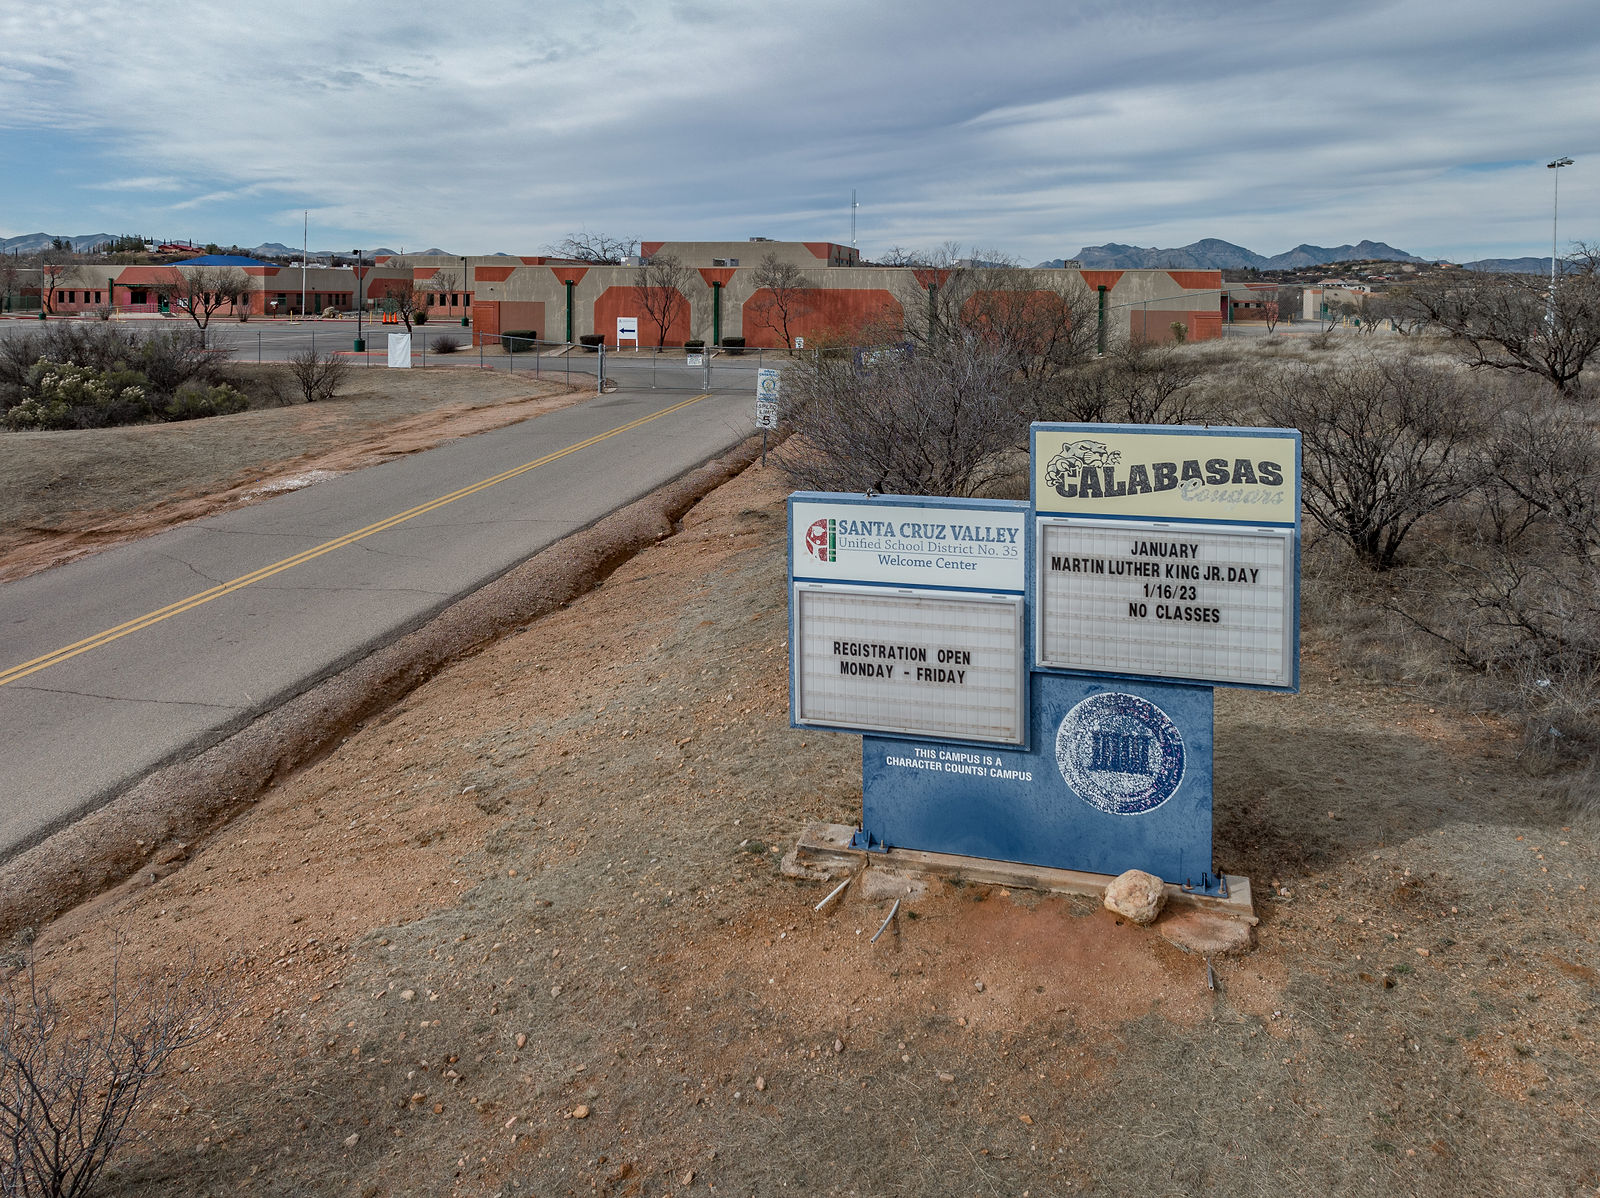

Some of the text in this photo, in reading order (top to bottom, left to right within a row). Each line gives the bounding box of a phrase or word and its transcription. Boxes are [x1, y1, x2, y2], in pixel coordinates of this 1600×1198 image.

[763, 416, 771, 426] 5
[1055, 459, 1284, 498] CALABASAS
[839, 520, 1019, 543] SANTA CRUZ VALLEY
[839, 537, 1018, 557] Unified School District No. 35
[1131, 541, 1199, 559] JANUARY
[878, 554, 977, 570] Welcome Center
[1051, 556, 1104, 574] MARTIN
[1109, 560, 1160, 578] LUTHER
[1166, 564, 1200, 580] KING
[1228, 567, 1259, 583] DAY
[1143, 583, 1197, 600] 1/16/23
[1129, 603, 1220, 623] NO CLASSES
[833, 641, 971, 665] REGISTRATION OPEN
[840, 661, 893, 679] MONDAY
[916, 667, 966, 684] FRIDAY
[915, 748, 1002, 766] THIS CAMPUS IS A
[886, 756, 1032, 781] CHARACTER COUNTS! CAMPUS
